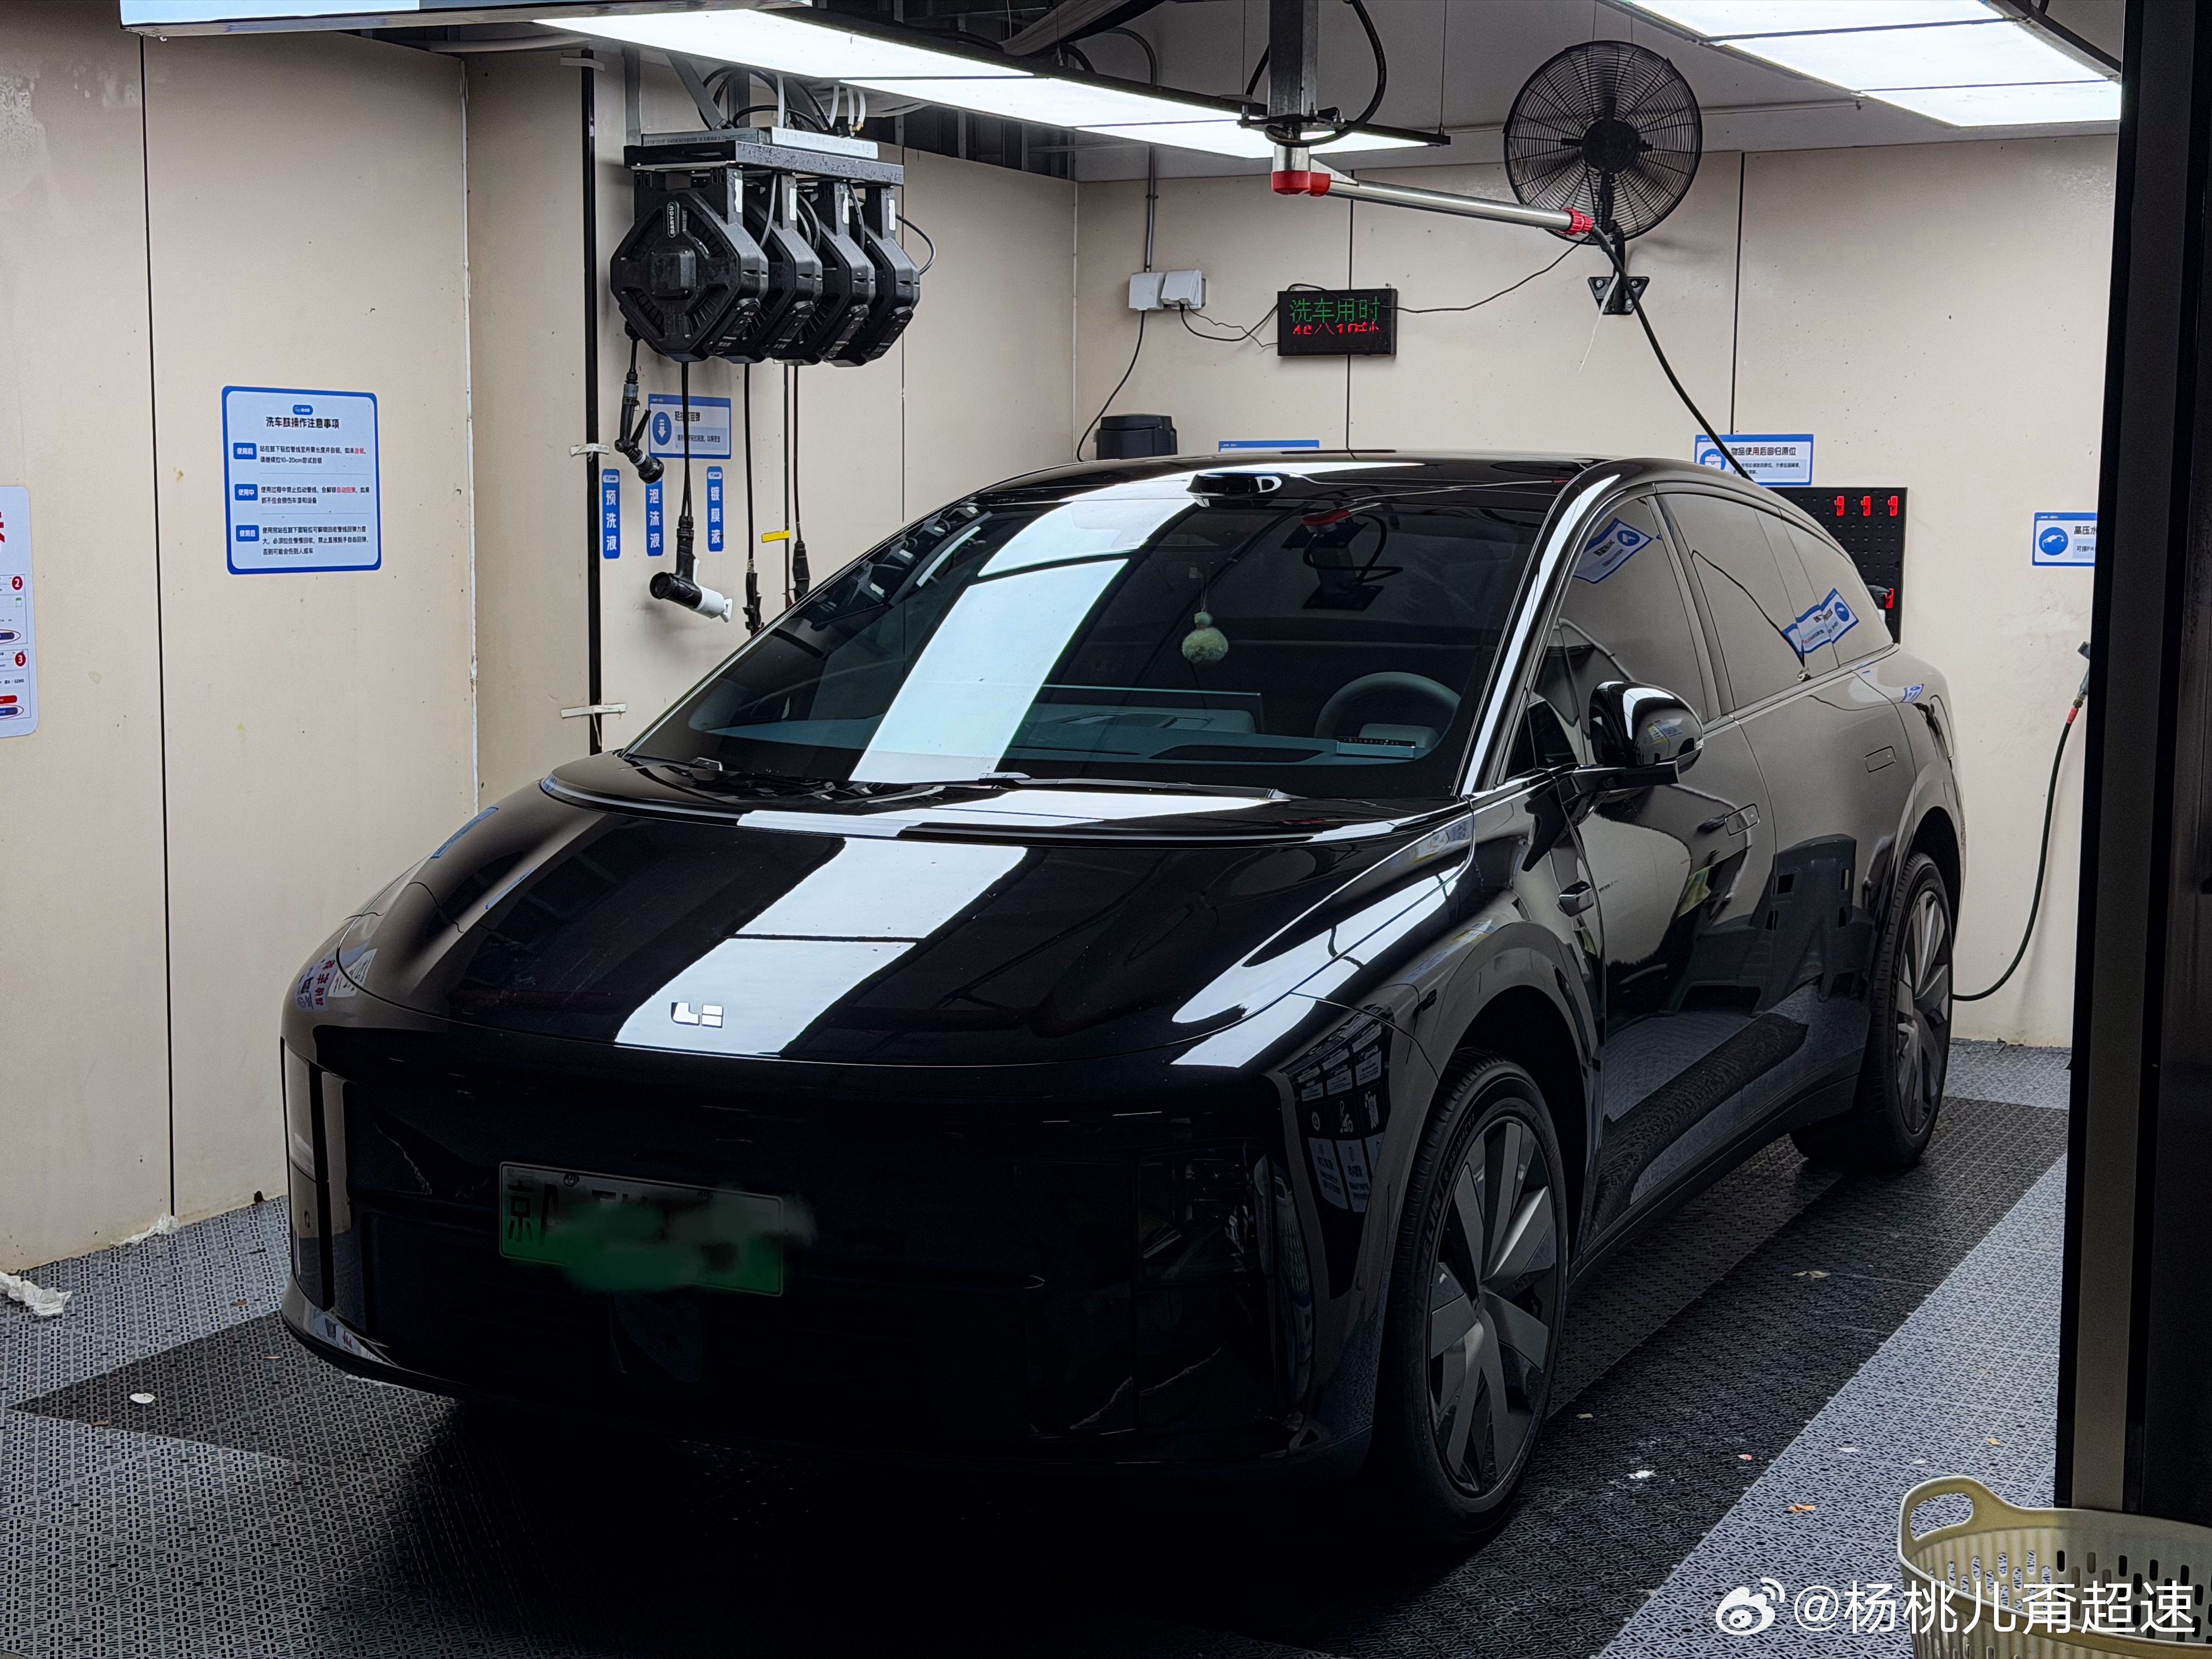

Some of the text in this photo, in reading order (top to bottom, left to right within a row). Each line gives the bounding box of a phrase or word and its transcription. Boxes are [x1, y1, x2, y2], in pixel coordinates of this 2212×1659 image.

[1290, 296, 1380, 323] 洗车用时
[1731, 447, 1797, 456] 物品使用后回归原位
[606, 489, 617, 551] 预洗液
[649, 488, 661, 549] 泡沫液
[710, 486, 720, 545] 镀膜液
[15, 578, 20, 588] 2
[18, 654, 23, 664] 3
